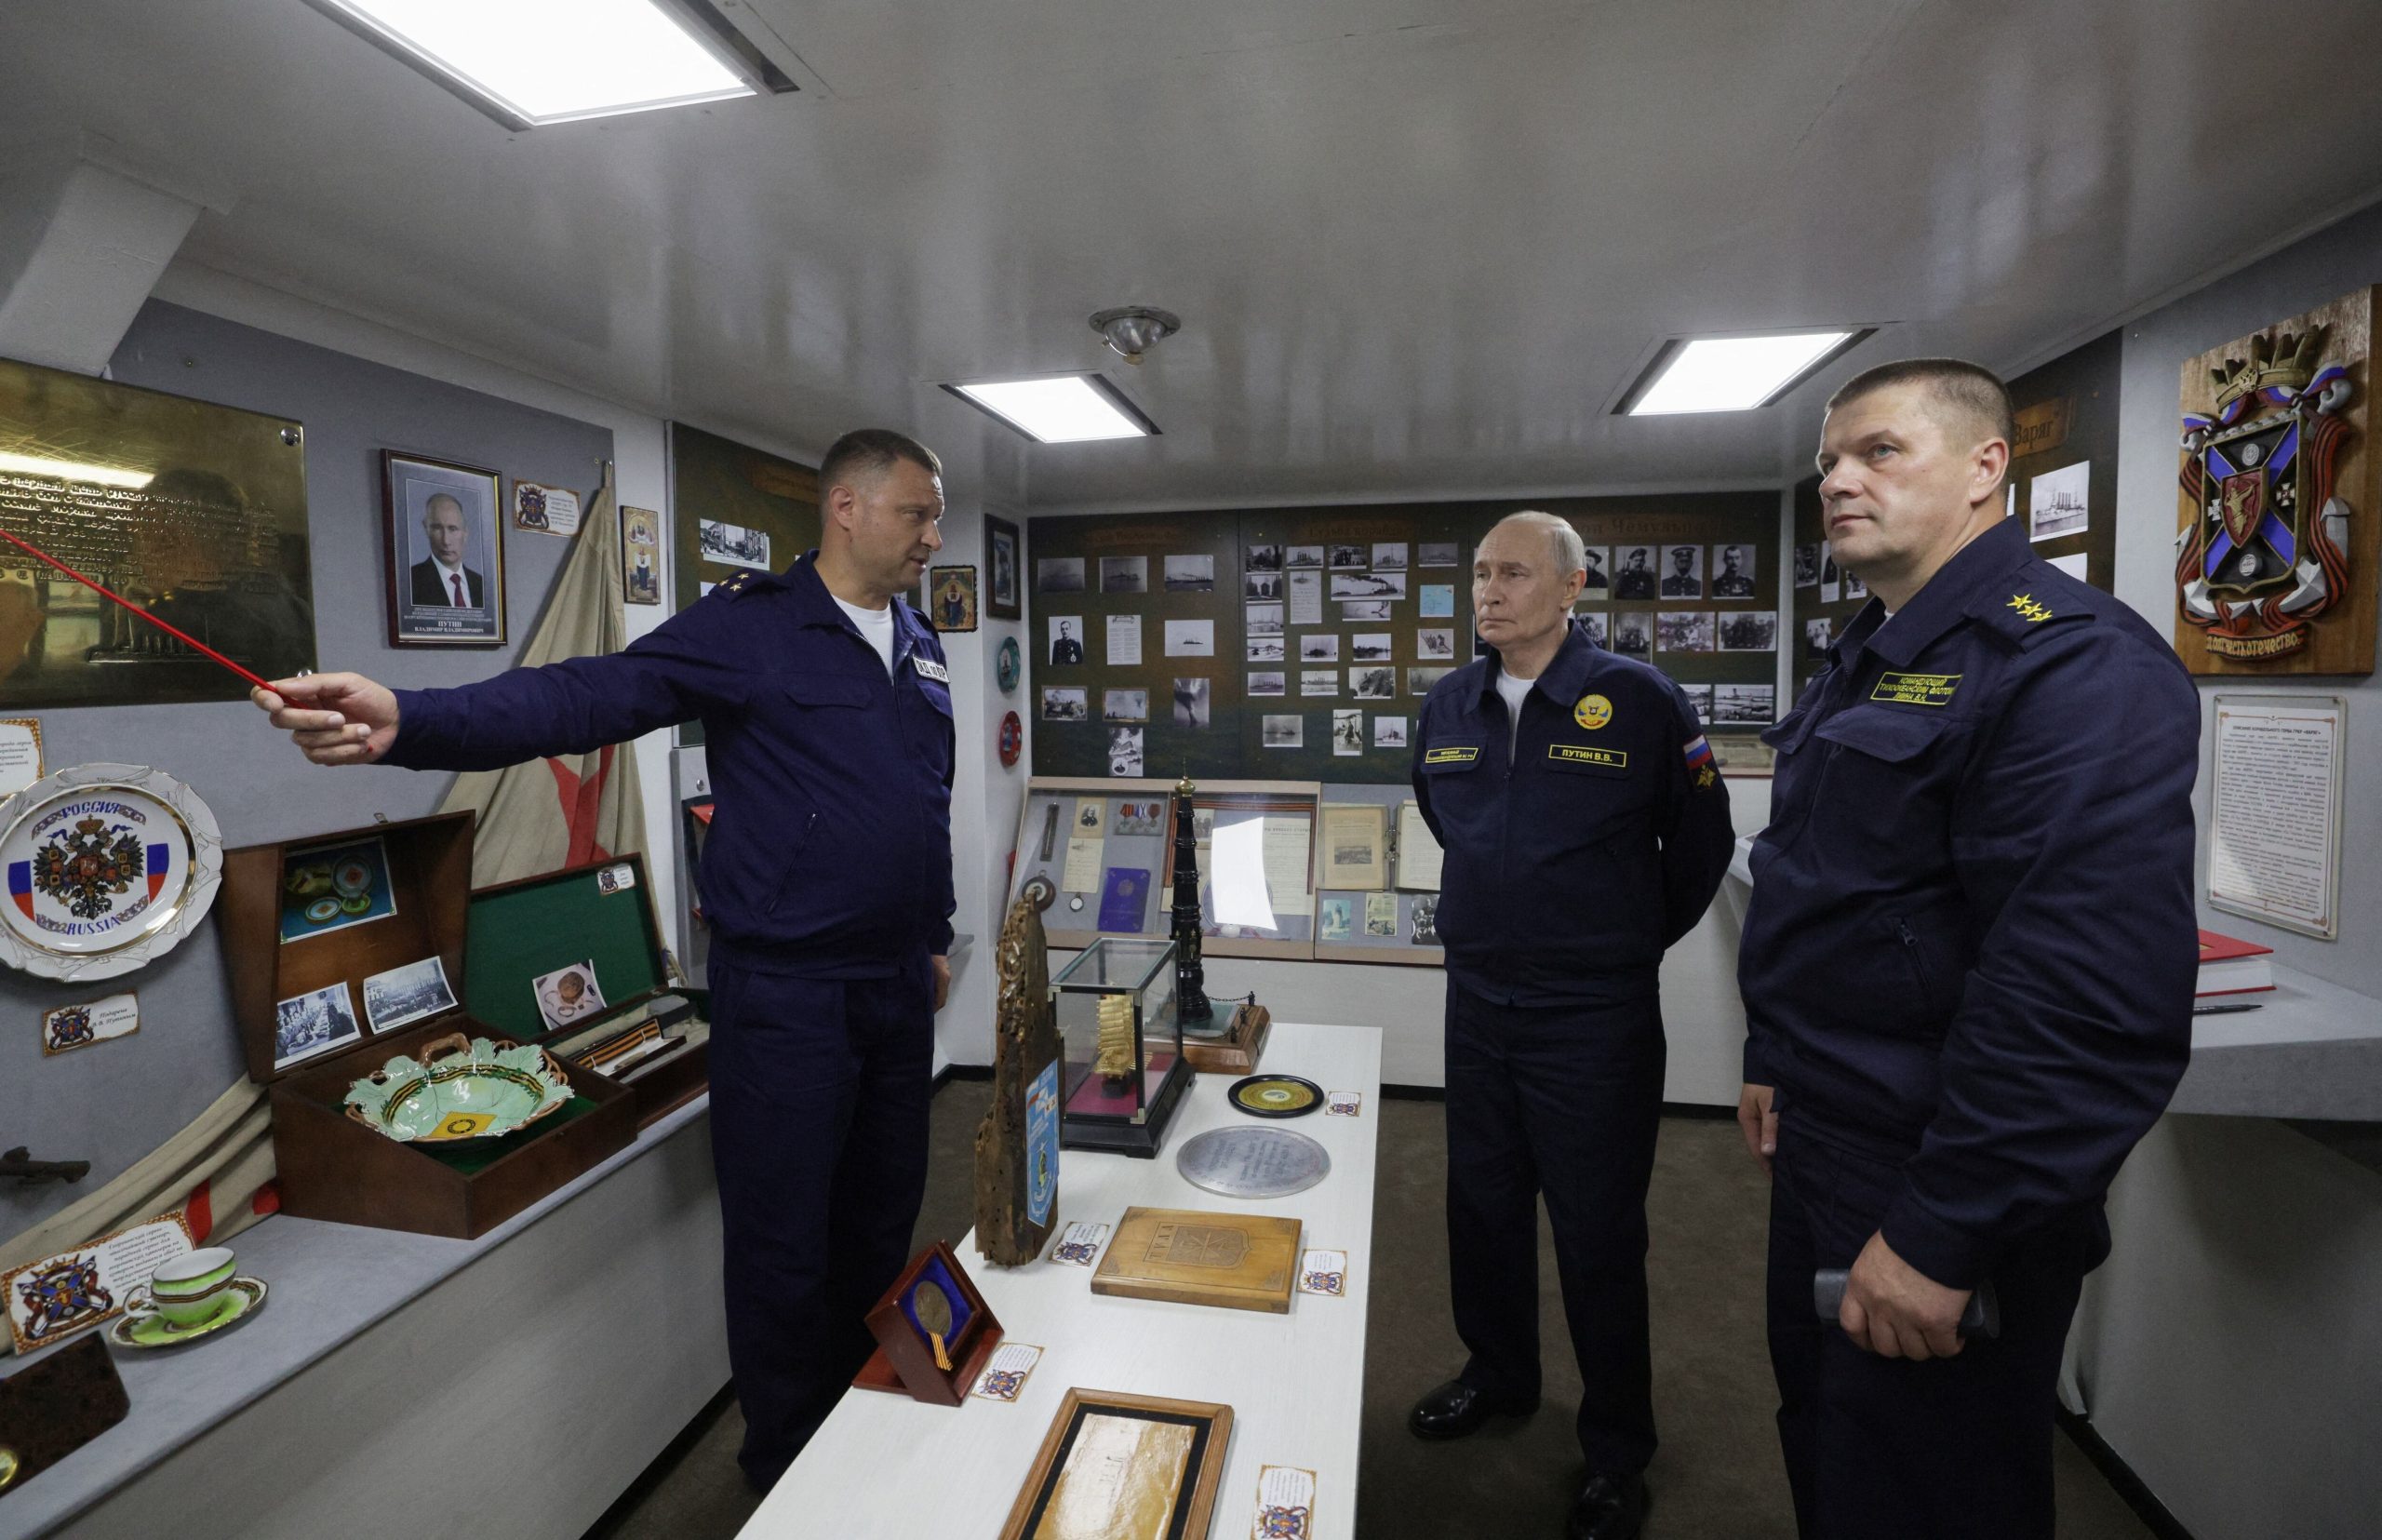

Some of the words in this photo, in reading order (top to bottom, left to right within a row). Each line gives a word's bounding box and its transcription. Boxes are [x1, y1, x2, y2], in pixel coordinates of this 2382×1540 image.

[1562, 748, 1593, 760] ПУТИН
[1595, 751, 1613, 762] В.В.
[62, 800, 120, 819] РОССИЯ
[67, 915, 121, 936] RUSSIA
